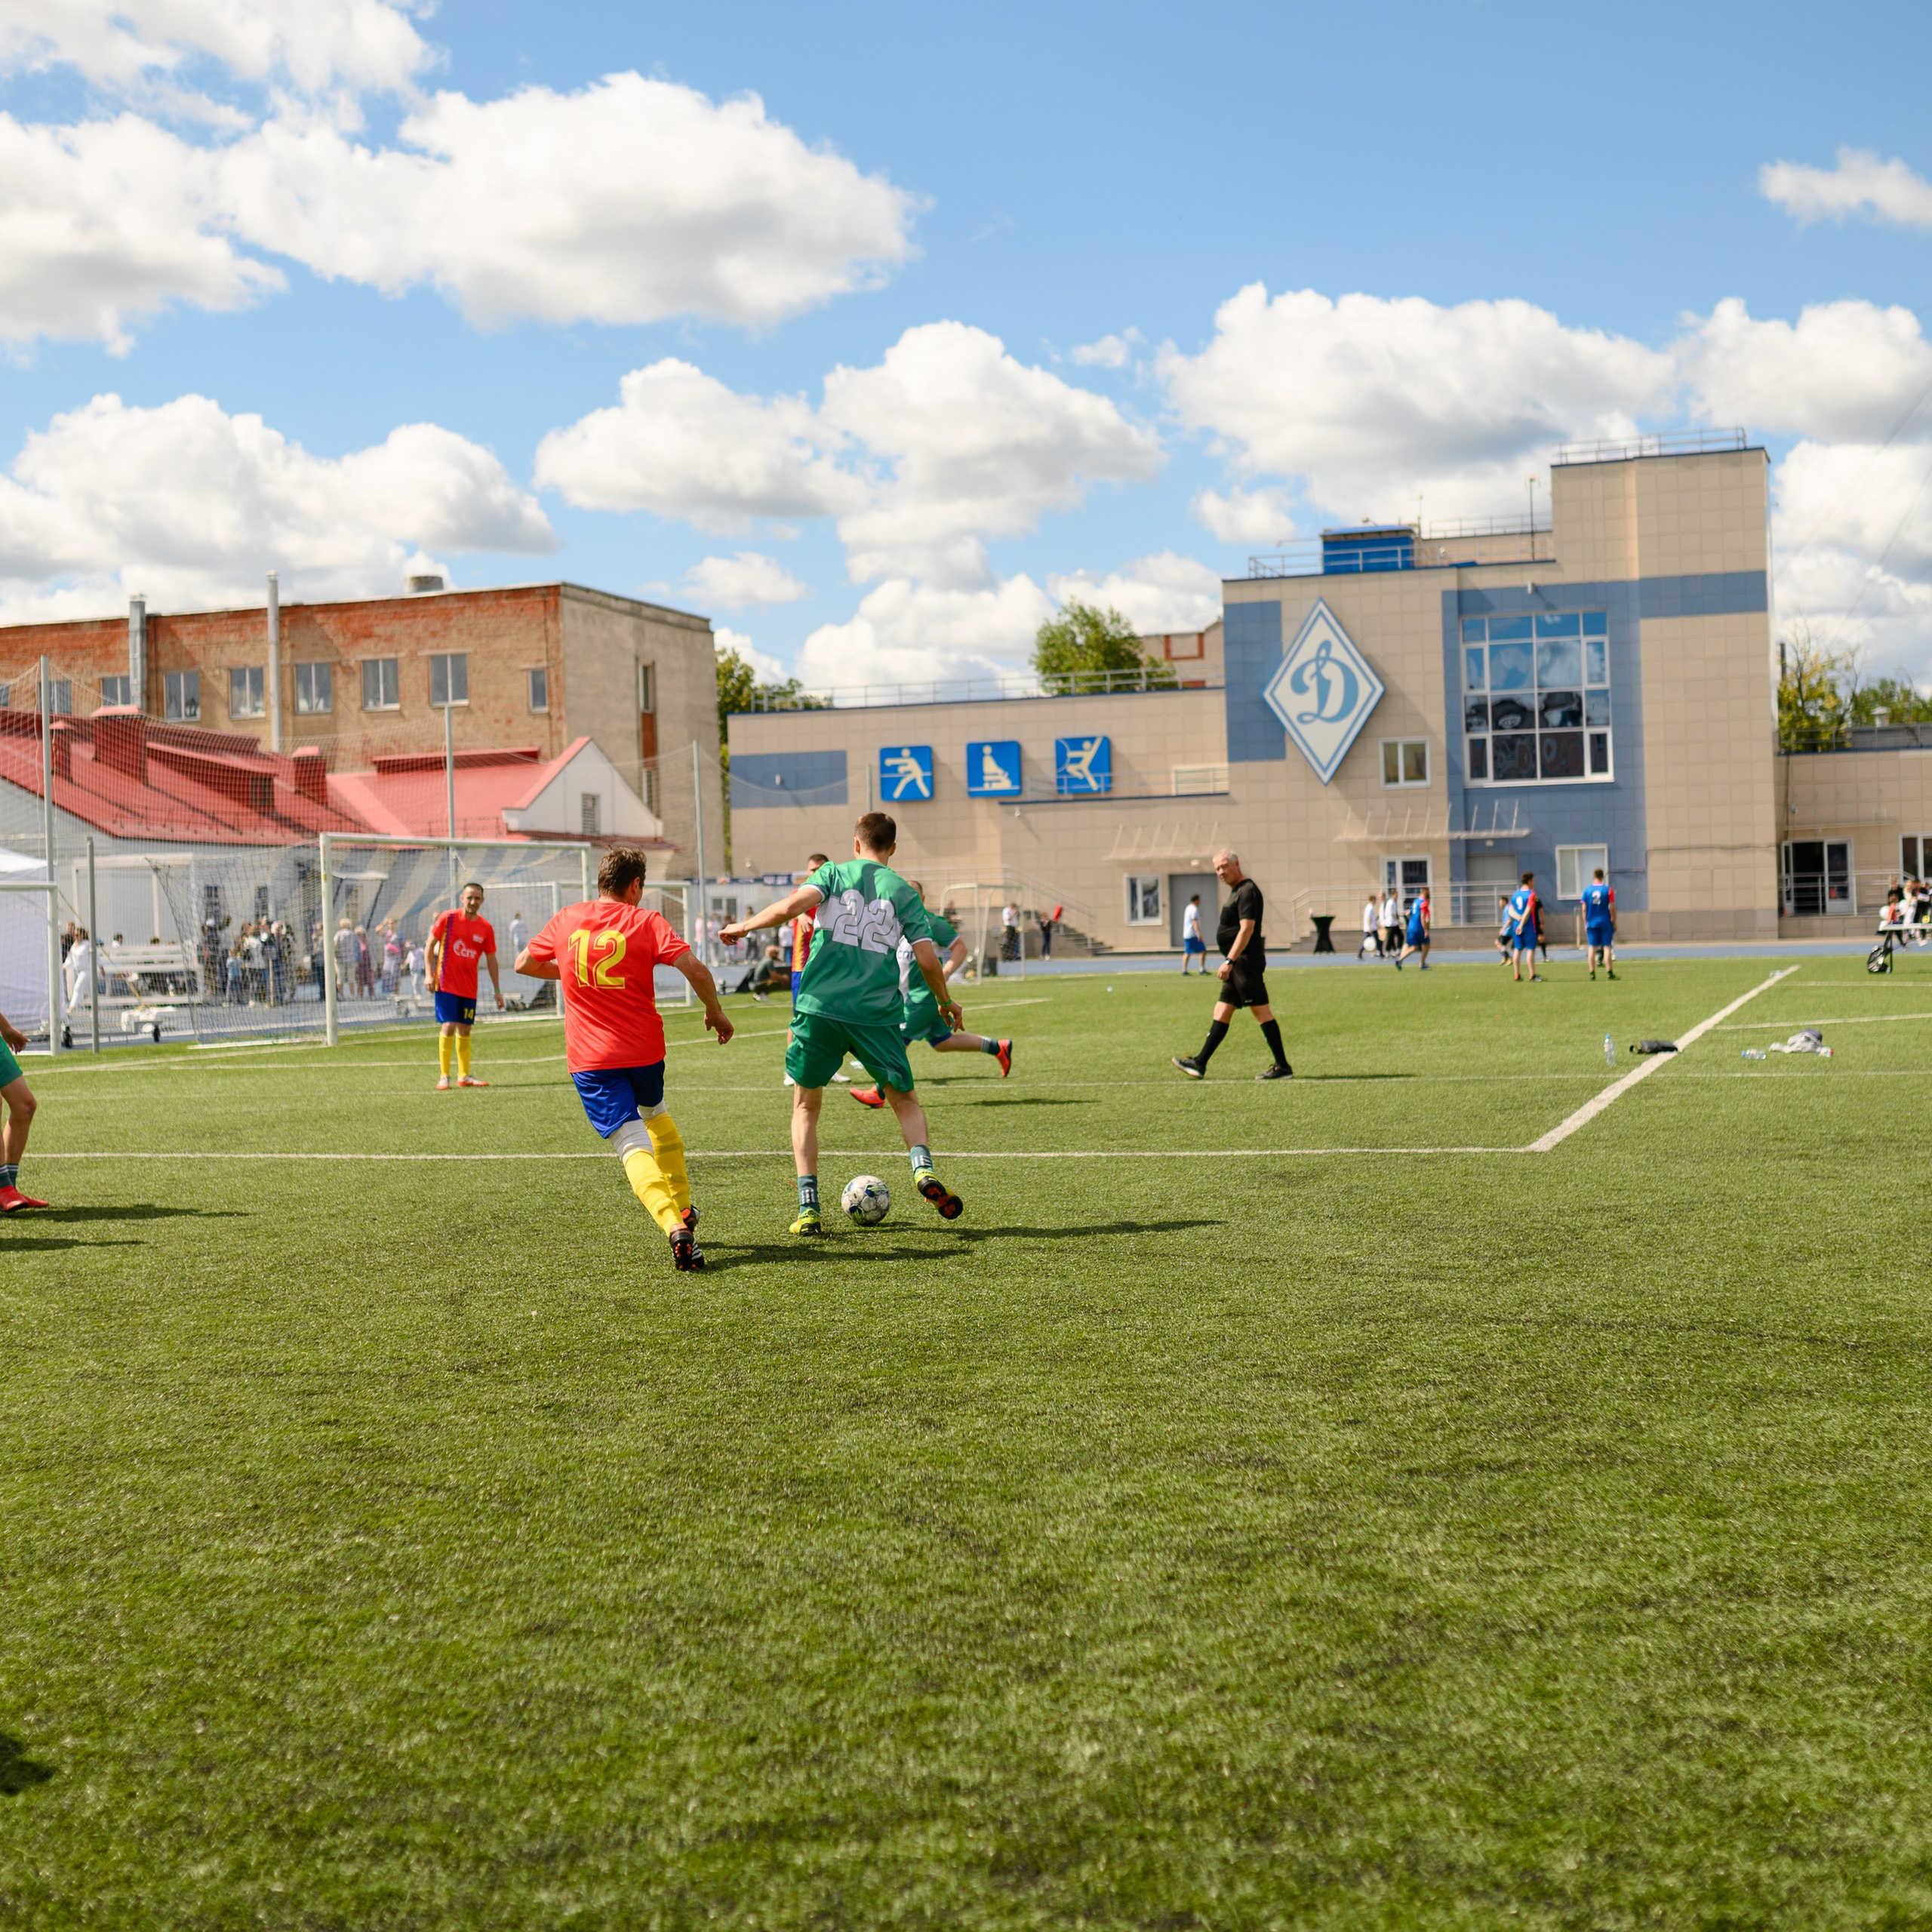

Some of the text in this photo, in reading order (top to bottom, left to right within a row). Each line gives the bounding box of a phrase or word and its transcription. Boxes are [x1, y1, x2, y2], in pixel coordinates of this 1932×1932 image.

[1592, 890, 1601, 905] 2
[832, 889, 895, 955] 22
[568, 929, 626, 989] 12
[463, 1008, 474, 1019] 14
